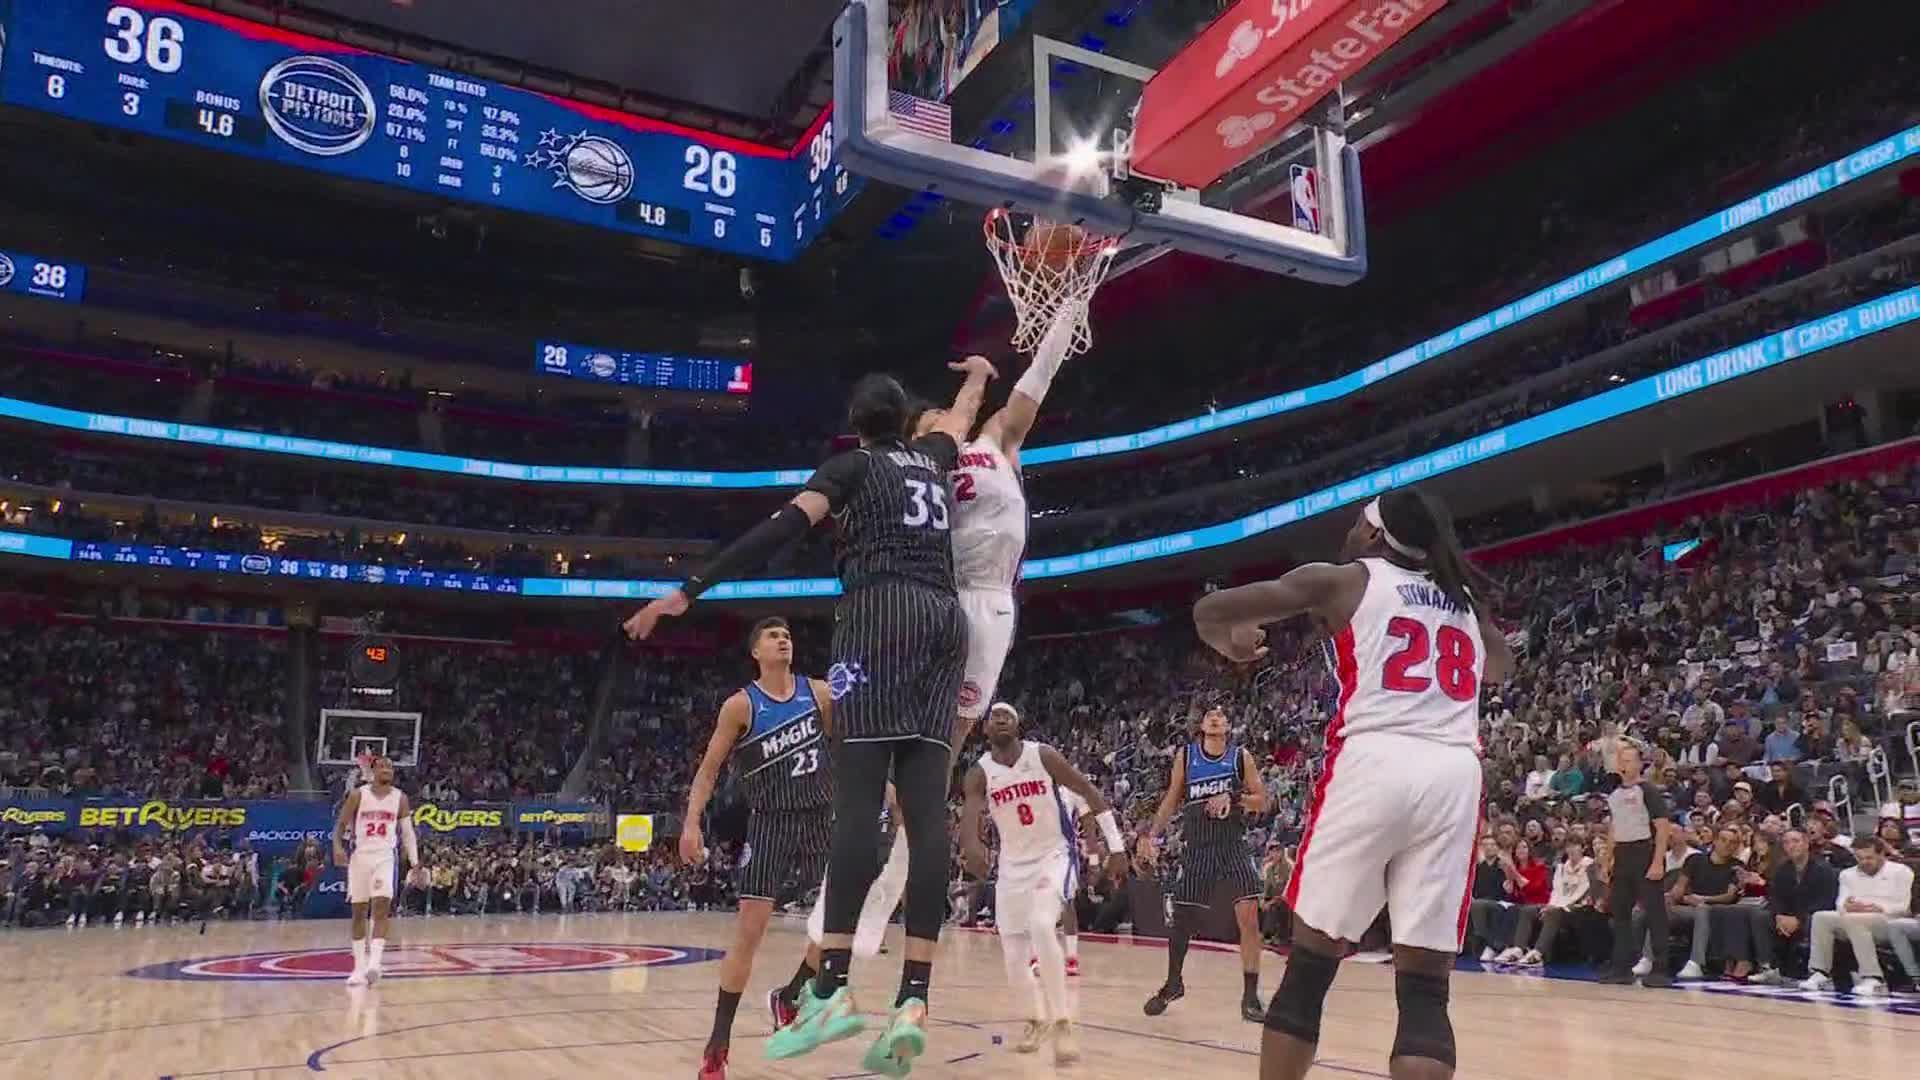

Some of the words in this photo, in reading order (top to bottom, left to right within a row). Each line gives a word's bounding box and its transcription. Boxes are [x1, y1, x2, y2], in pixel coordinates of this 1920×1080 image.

[104, 6, 184, 73] 36
[284, 81, 355, 112] DETROIT
[428, 73, 454, 89] TEAM
[456, 80, 487, 97] STATS
[123, 92, 140, 116] 3
[196, 90, 240, 111] BONUS
[281, 97, 355, 128] PISTONS
[809, 121, 832, 184] 36
[396, 162, 411, 177] 10
[683, 145, 737, 198] 26
[1720, 197, 1763, 232] LONG
[1766, 173, 1821, 214] DRINK
[1655, 363, 1703, 399] LONG
[1706, 340, 1768, 382] DRINK
[903, 479, 949, 530] 35
[1382, 616, 1477, 702] 28
[761, 717, 817, 759] MAGIC
[791, 749, 819, 777] 23
[991, 781, 1048, 806] PISTONS
[1190, 779, 1233, 799] MAGIC
[80, 801, 246, 831] BETRIVERS
[1017, 803, 1034, 826] 8
[366, 823, 387, 837] 24
